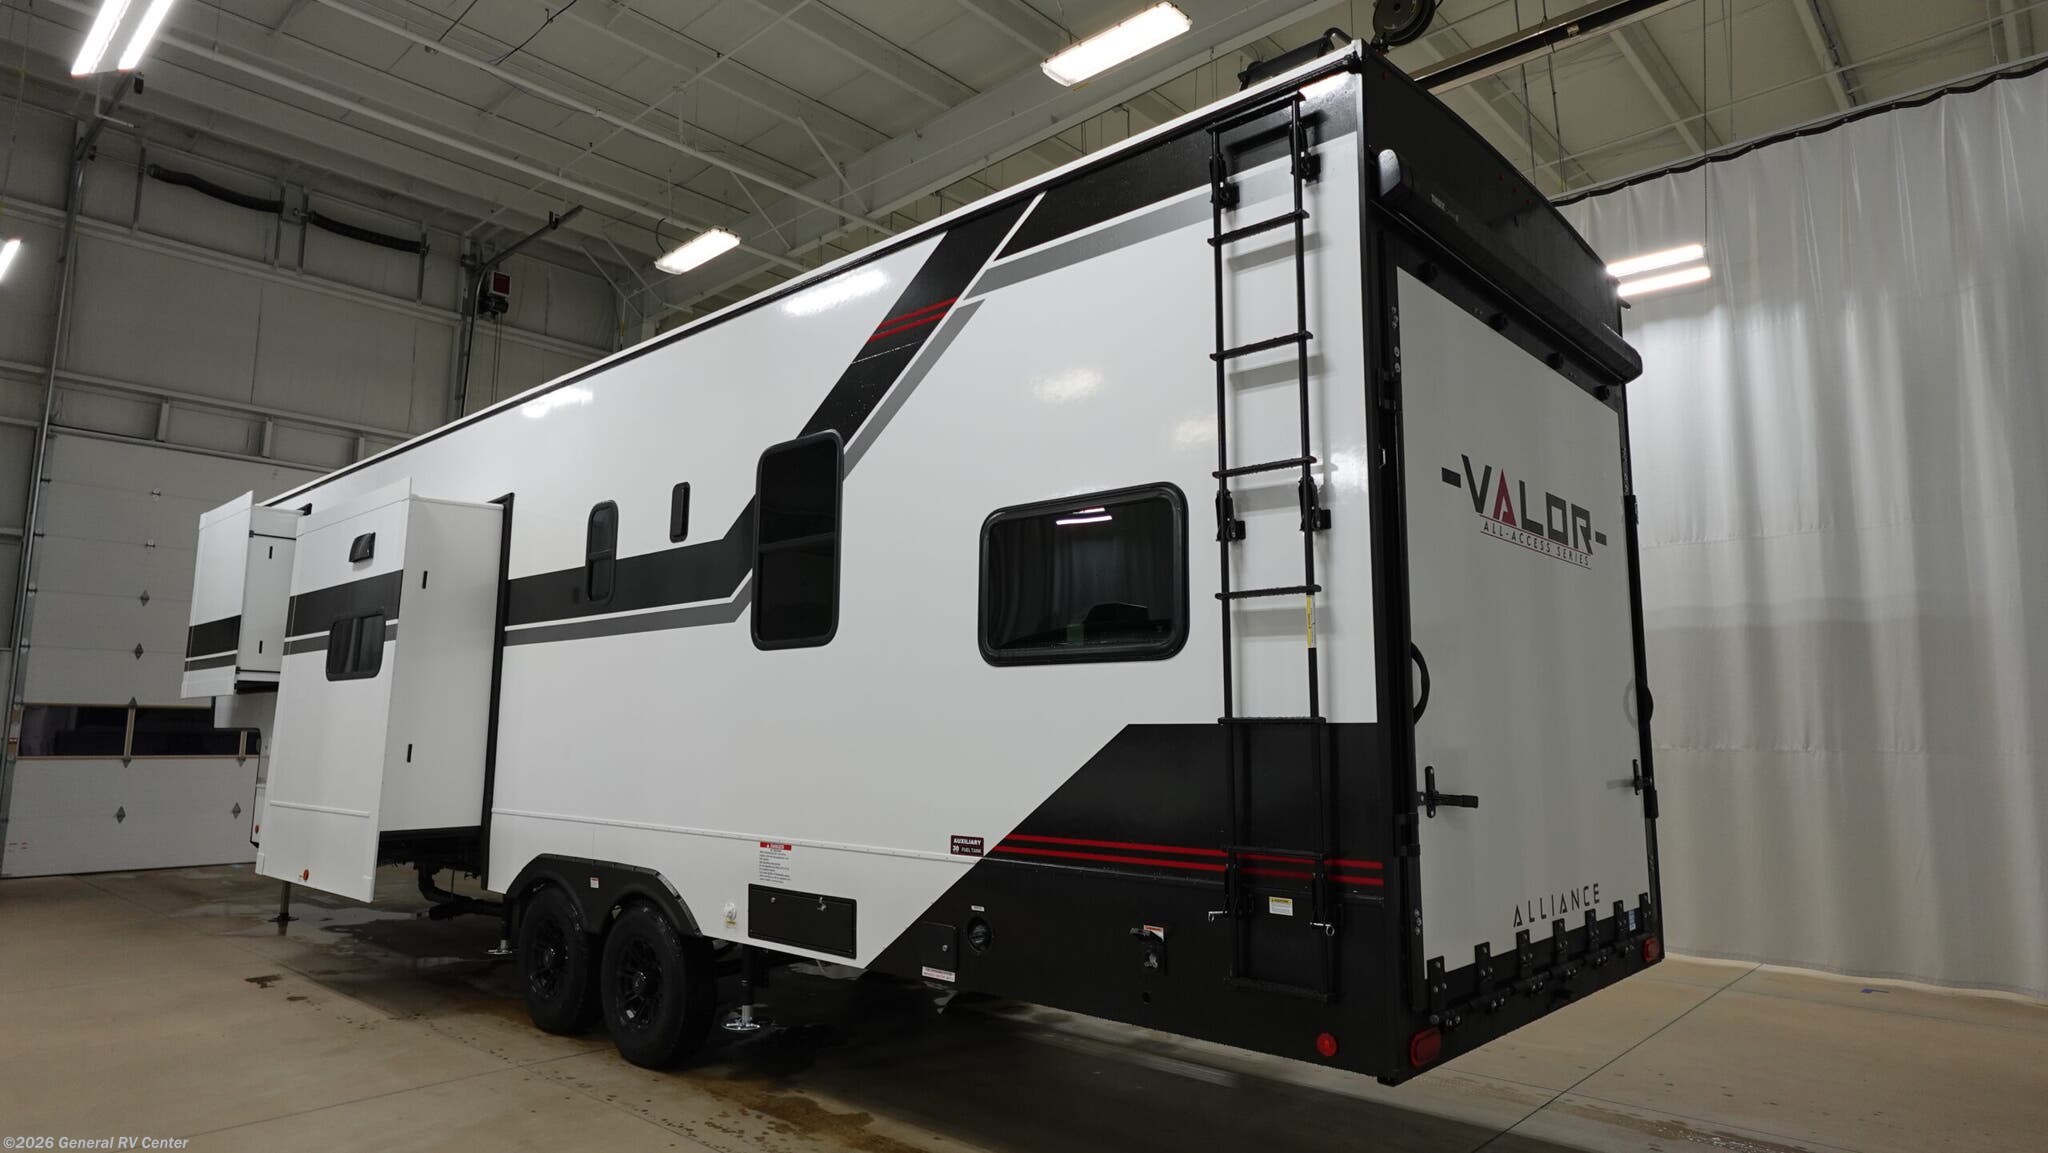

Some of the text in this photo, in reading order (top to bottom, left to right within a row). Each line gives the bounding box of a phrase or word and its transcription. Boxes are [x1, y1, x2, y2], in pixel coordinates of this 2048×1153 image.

[1483, 521, 1590, 566] ALL-ACCESS SERIES
[953, 837, 982, 846] AUXILIARY
[1513, 882, 1600, 928] ALLIANCE
